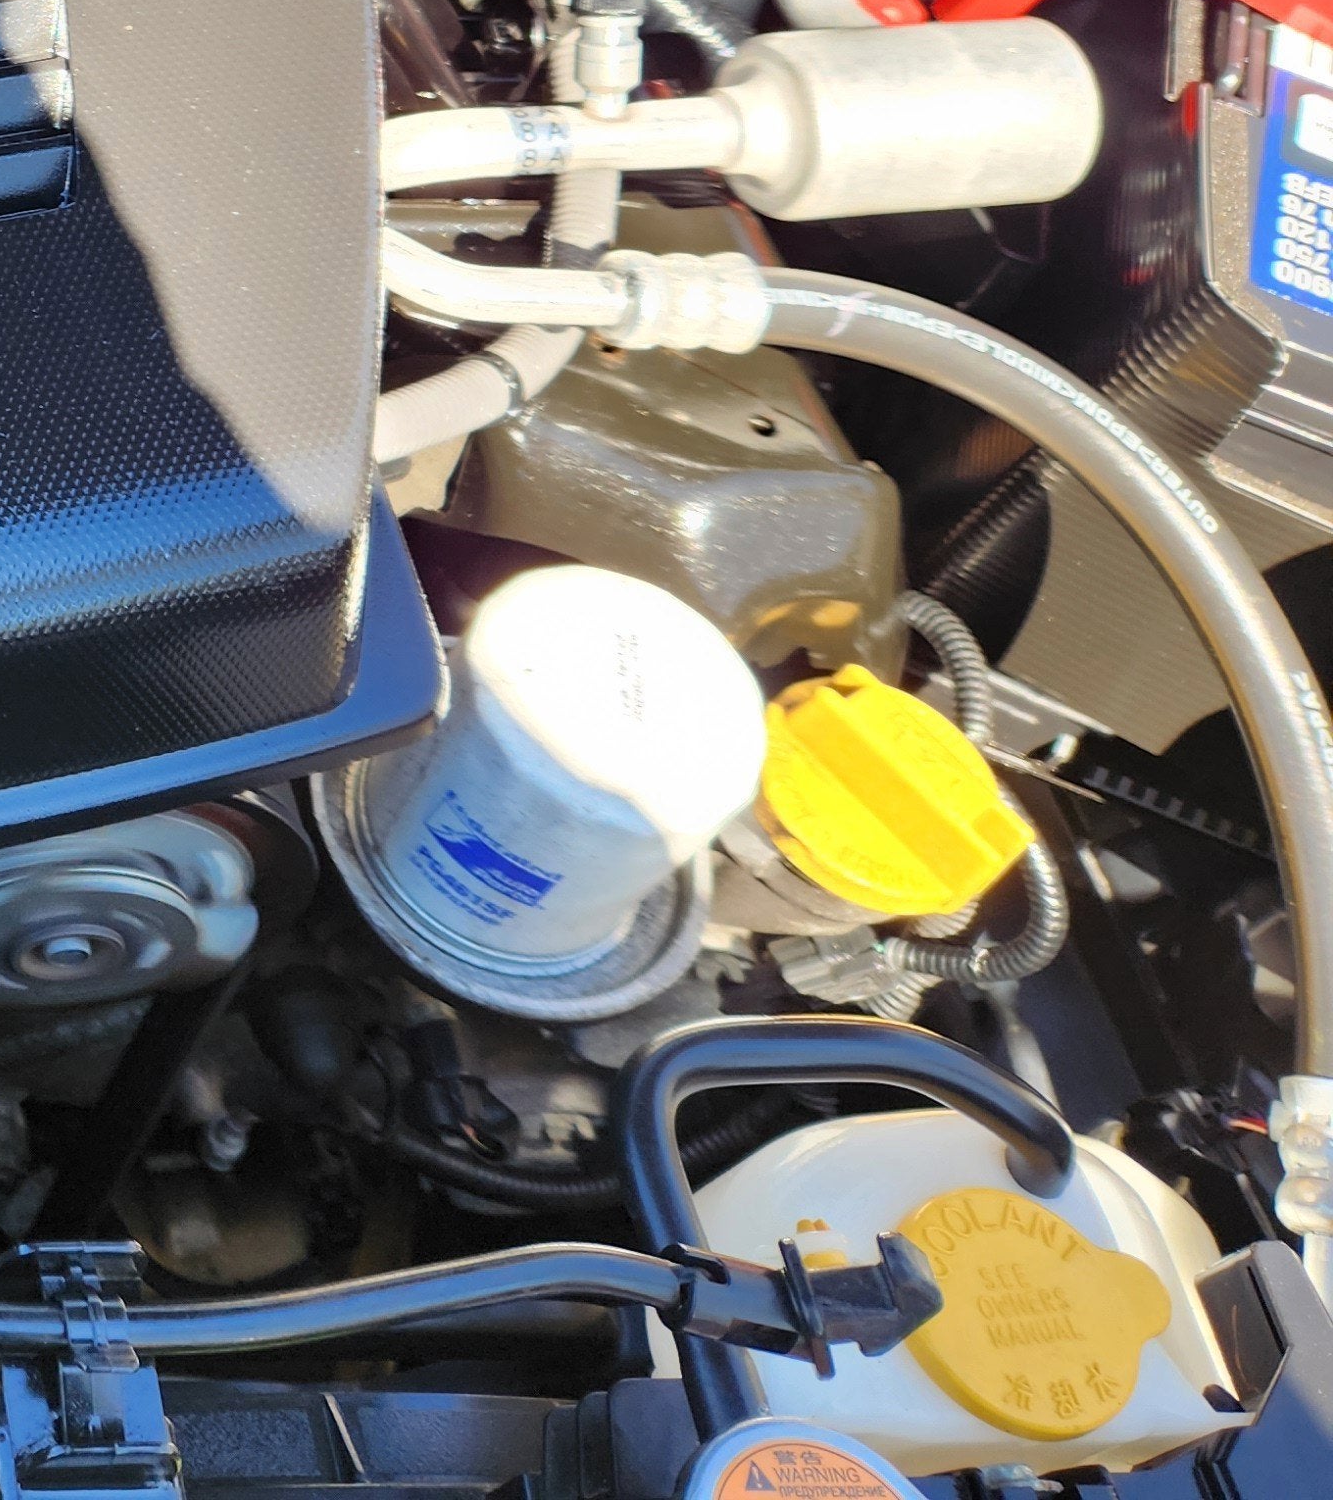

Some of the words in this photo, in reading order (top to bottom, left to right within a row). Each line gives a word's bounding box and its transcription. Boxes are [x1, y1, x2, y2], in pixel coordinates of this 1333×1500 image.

[977, 1263, 1031, 1290] SEE
[976, 1287, 1071, 1320] OWNERS
[985, 1315, 1085, 1348] MANUAL
[773, 1466, 861, 1484] WARNING
[778, 1485, 887, 1499] ПРЕДУПРЕЖДЕНИЕ
